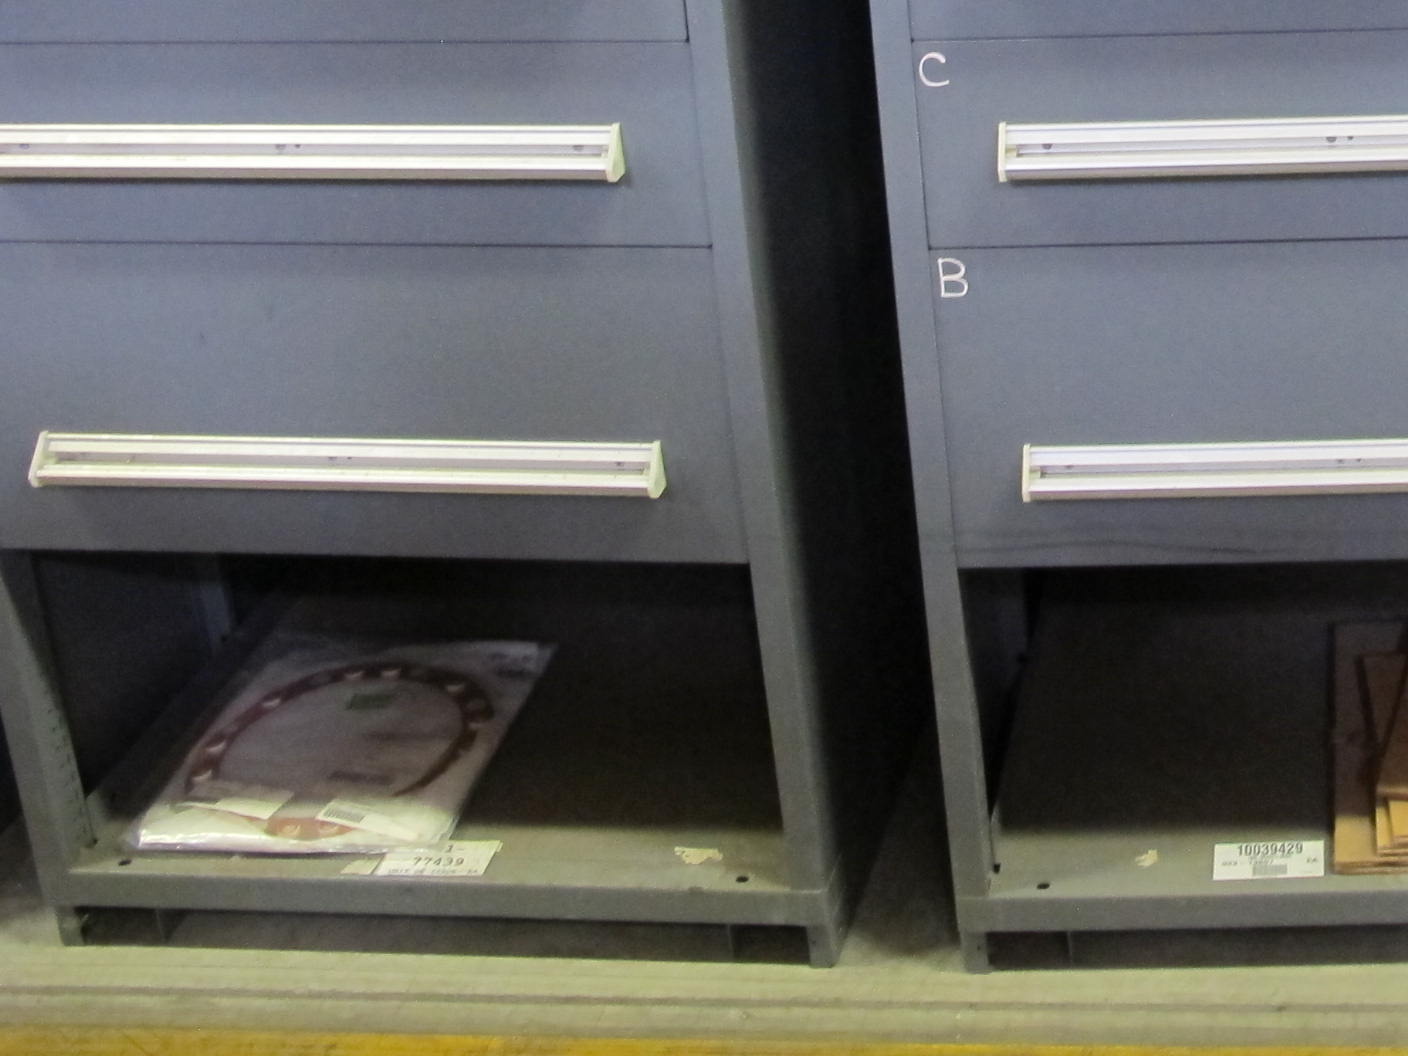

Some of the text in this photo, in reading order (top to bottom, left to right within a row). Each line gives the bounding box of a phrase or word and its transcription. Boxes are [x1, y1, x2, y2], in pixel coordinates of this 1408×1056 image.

[918, 51, 951, 88] C
[937, 257, 969, 299] B
[413, 855, 465, 866] 77439
[1236, 842, 1304, 857] 10039429
